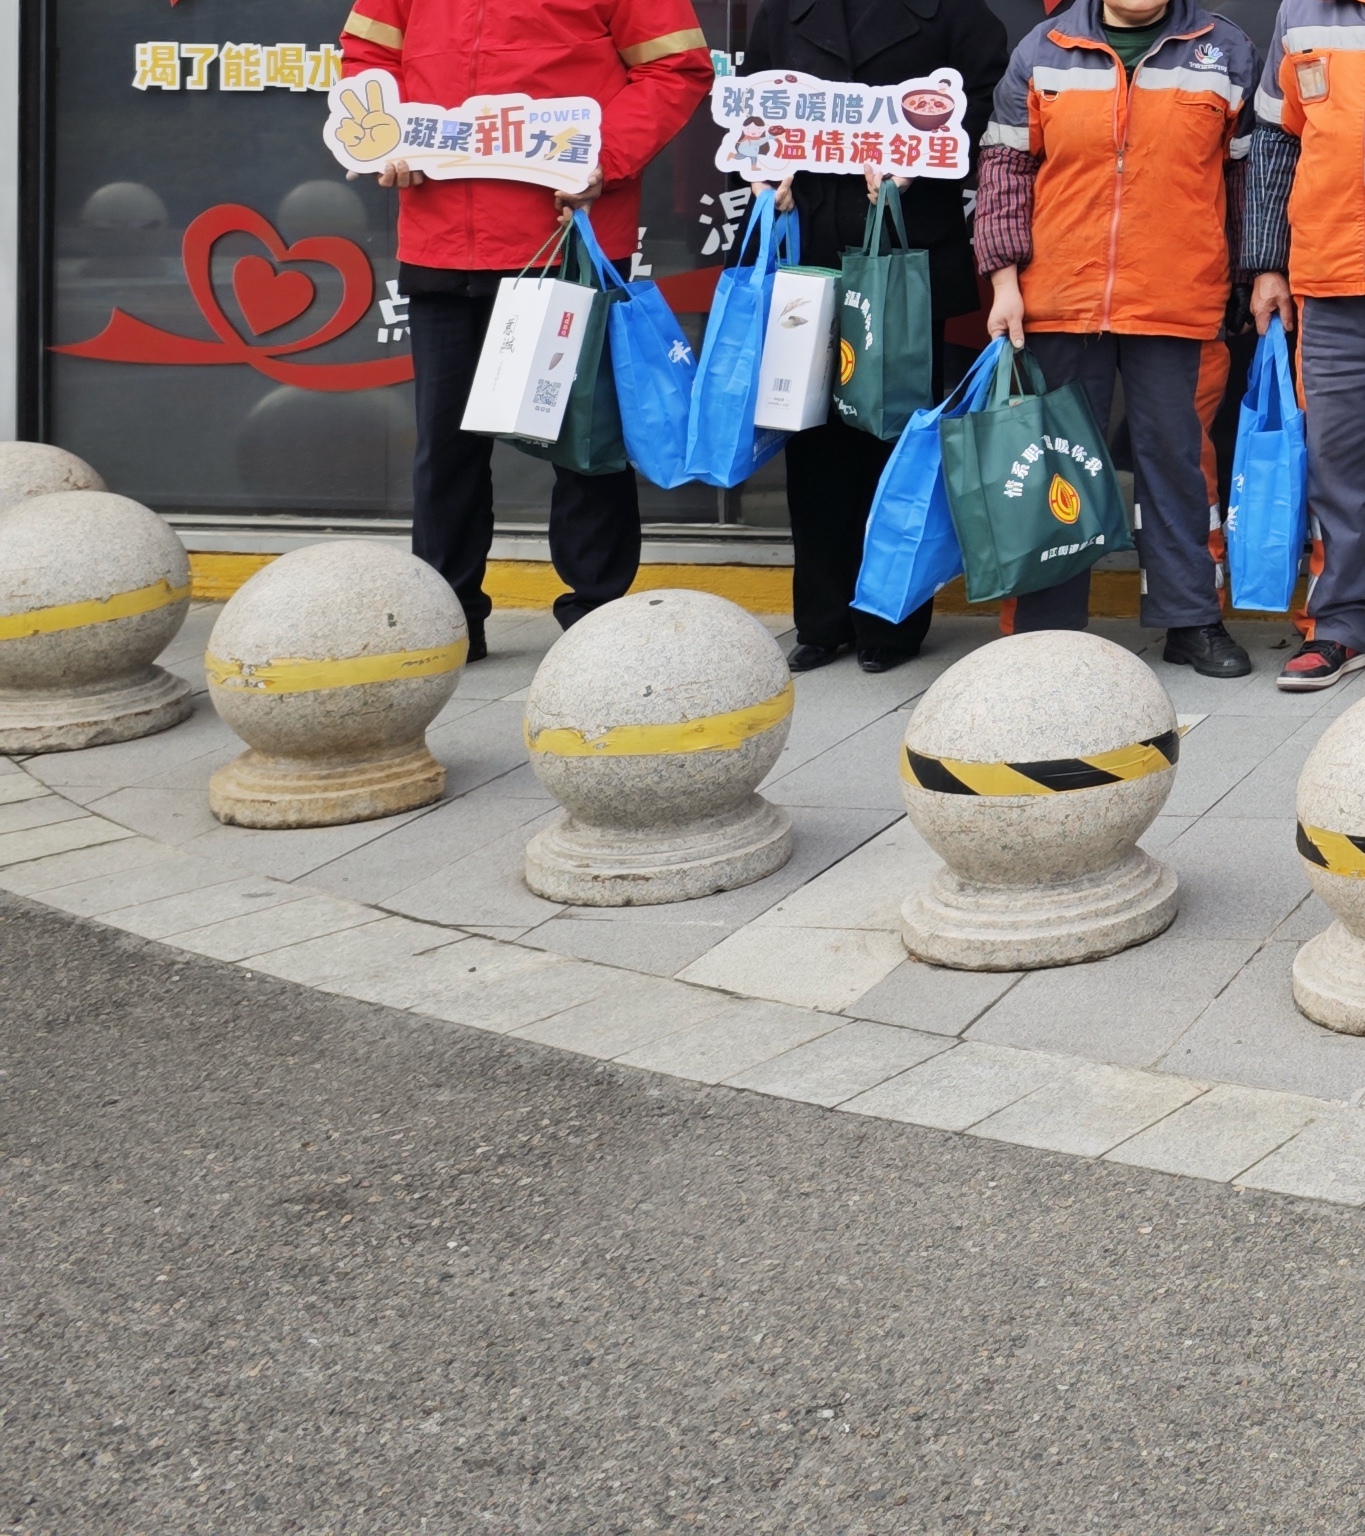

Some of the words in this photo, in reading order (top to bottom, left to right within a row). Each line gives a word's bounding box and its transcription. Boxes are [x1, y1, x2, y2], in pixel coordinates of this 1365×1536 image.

[132, 41, 344, 92] 渴了能喝水
[528, 108, 592, 125] POWER
[722, 86, 900, 126] 粥香暖腊八
[403, 105, 593, 165] 凝聚新力量
[773, 127, 960, 169] 温情满邻里
